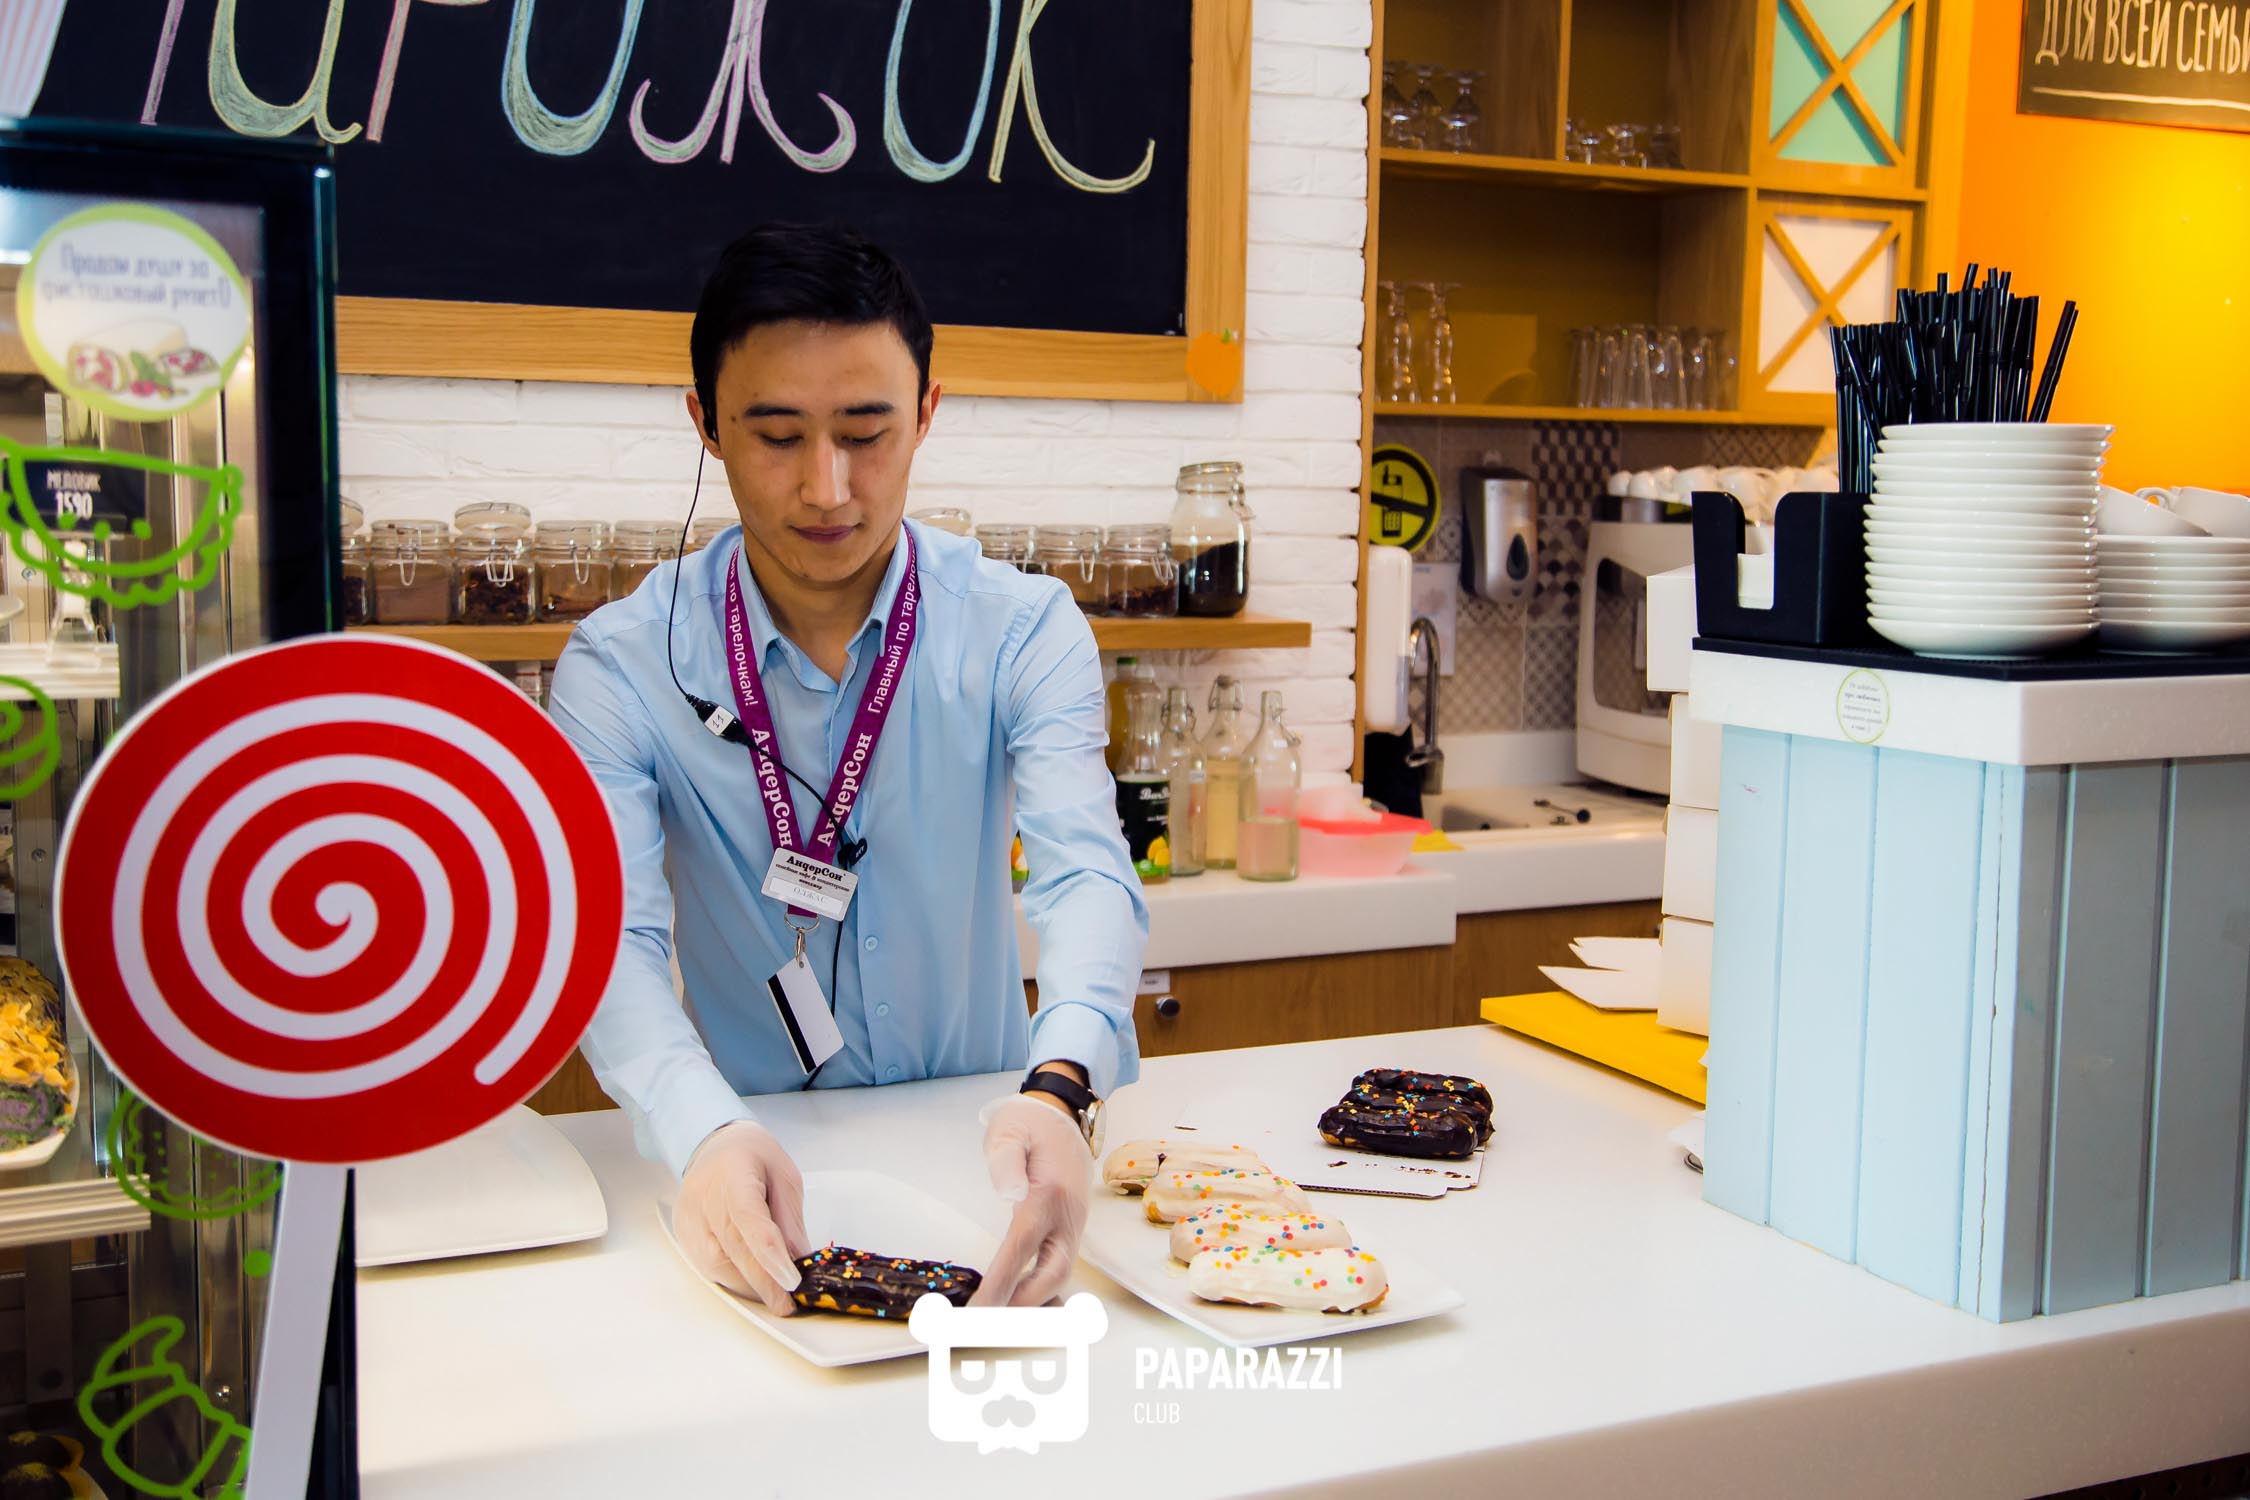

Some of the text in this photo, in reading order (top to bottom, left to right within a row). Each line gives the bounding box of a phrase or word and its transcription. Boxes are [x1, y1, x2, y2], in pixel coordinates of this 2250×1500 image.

[2034, 0, 2098, 66] ДЛЯ
[2176, 1, 2250, 73] СЕМЬ
[728, 604, 759, 707] тарелочкам!
[867, 645, 904, 714] Главный
[895, 622, 911, 643] по
